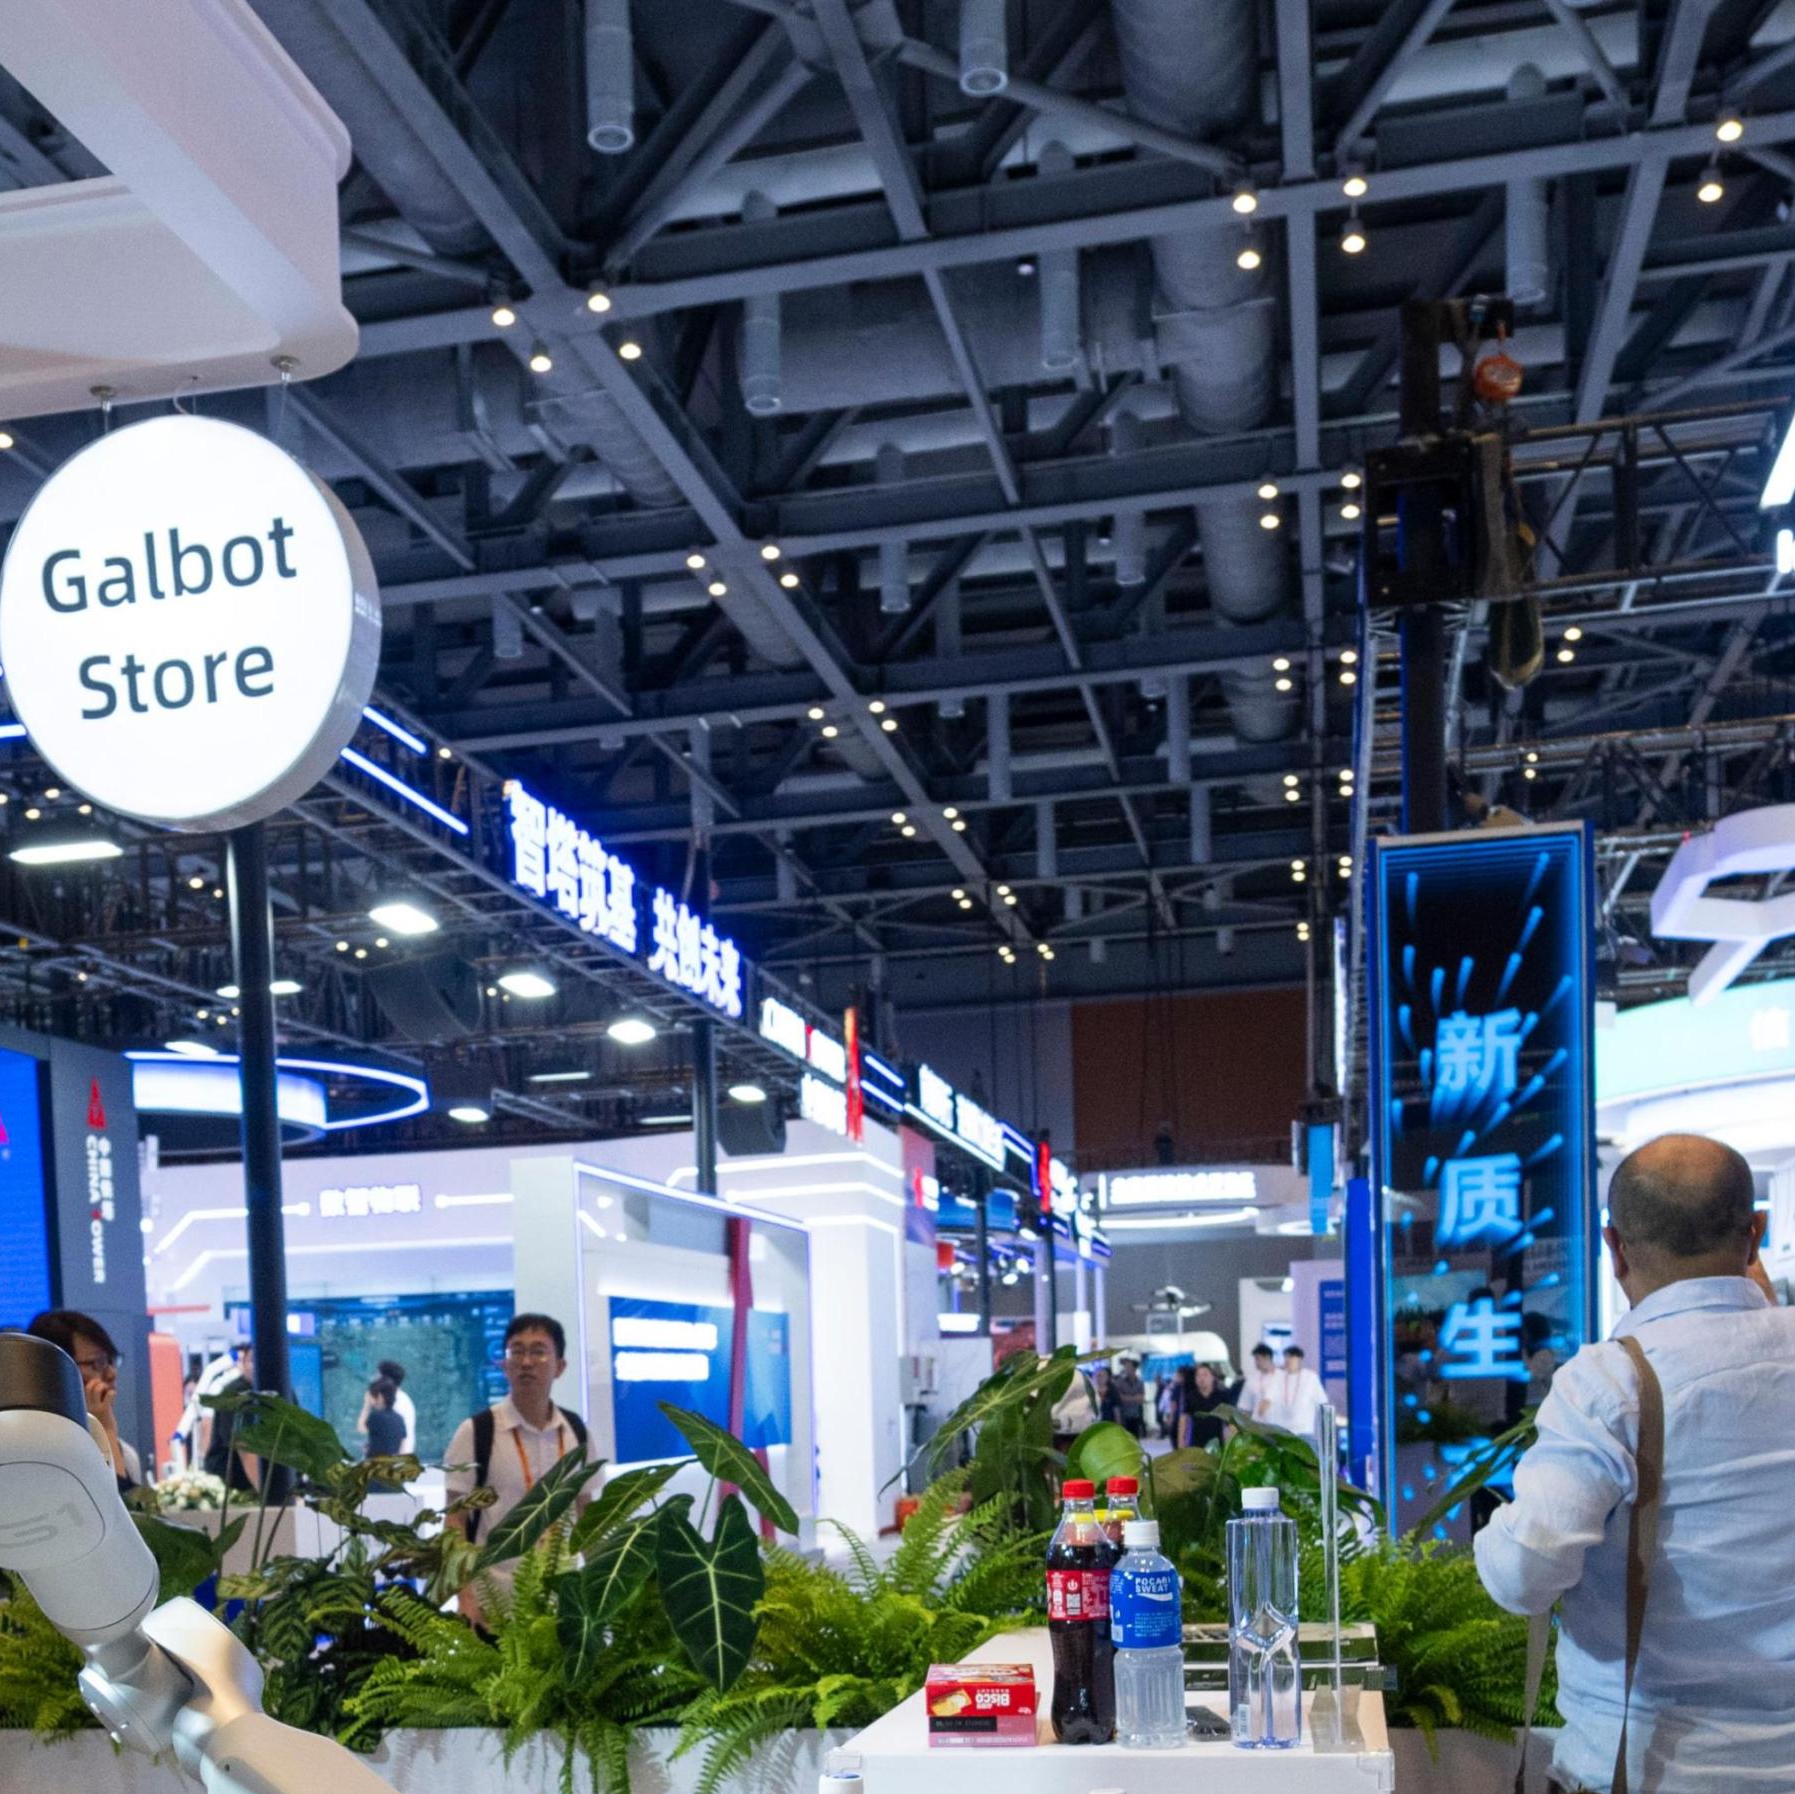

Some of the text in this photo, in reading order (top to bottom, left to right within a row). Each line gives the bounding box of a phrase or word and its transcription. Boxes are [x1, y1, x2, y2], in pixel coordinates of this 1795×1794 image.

[41, 517, 298, 614] Galbot
[78, 644, 275, 720] Store
[1135, 1584, 1169, 1593] SWEAT
